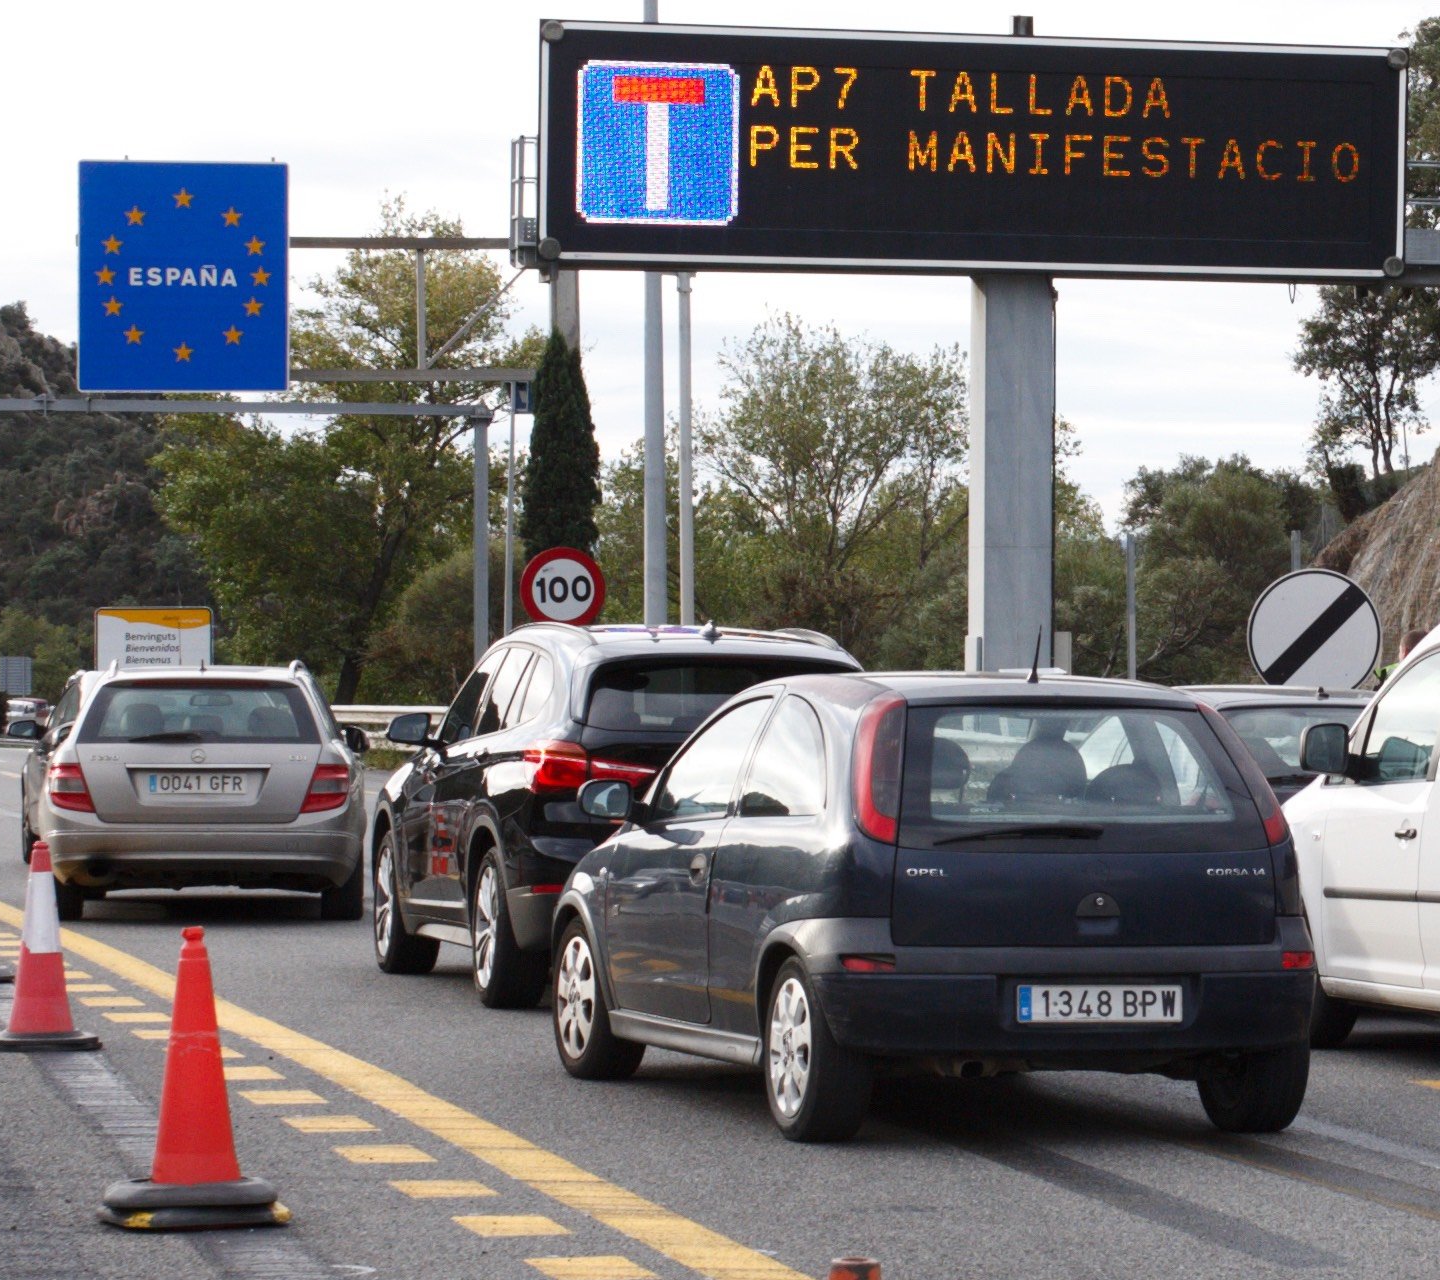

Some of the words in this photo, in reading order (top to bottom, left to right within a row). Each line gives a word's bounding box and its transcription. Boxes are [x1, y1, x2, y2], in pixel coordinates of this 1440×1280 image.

[750, 64, 857, 112] AP7
[910, 69, 1172, 121] TALLADA
[748, 125, 860, 172] PER
[908, 128, 1361, 184] MANIFESTACIO
[128, 264, 238, 287] ESPAÑA
[536, 575, 591, 603] 100
[125, 632, 177, 643] Benvinguts
[125, 643, 181, 653] Bienvenidos
[125, 655, 172, 665] Bienvenus
[160, 775, 201, 791] 0041
[209, 775, 242, 792] GFR
[906, 868, 948, 877] OPEL
[1206, 867, 1249, 877] CORSA
[1041, 990, 1113, 1018] 1348
[1122, 990, 1176, 1018] BPW
